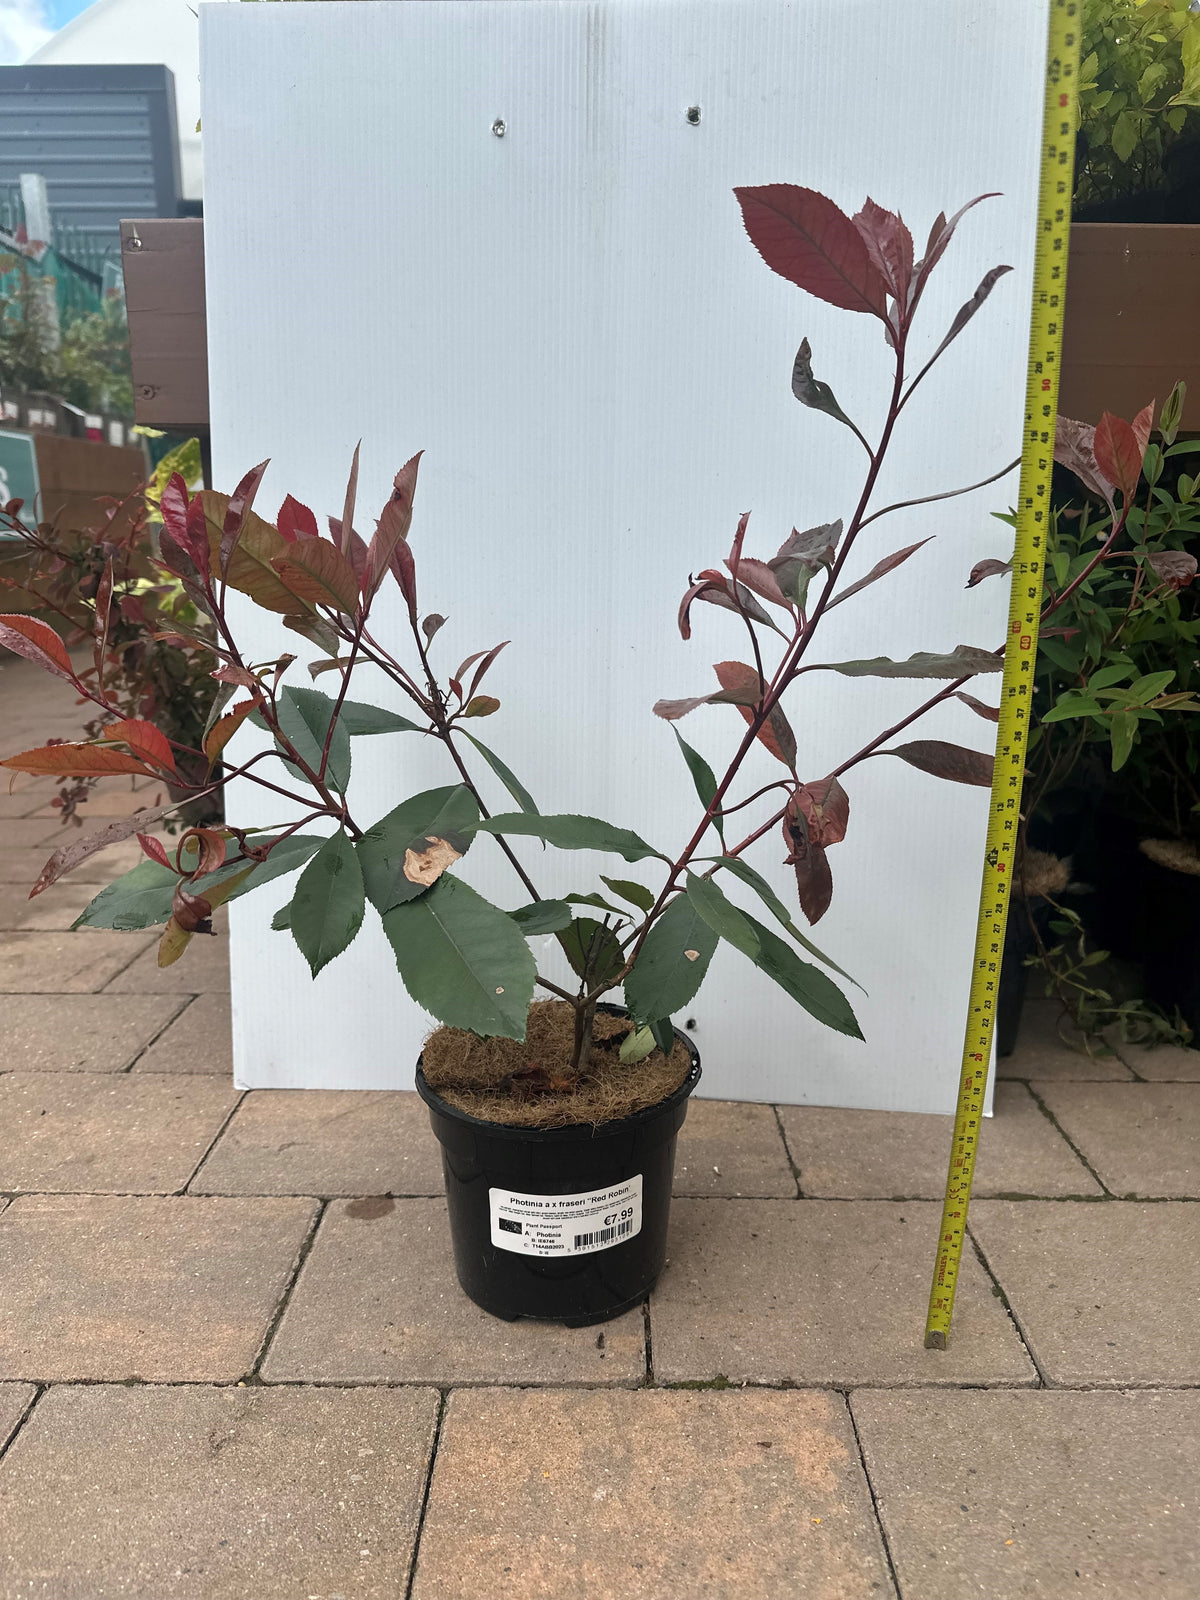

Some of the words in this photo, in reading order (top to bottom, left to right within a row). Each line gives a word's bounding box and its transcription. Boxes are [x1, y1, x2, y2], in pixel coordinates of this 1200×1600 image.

[1057, 181, 1065, 193] 57
[1055, 210, 1063, 222] 56
[1054, 238, 1062, 251] 55
[1052, 266, 1060, 279] 54
[1040, 294, 1047, 304] 21
[1050, 296, 1058, 307] 53
[1048, 323, 1056, 335] 52
[1047, 351, 1054, 362] 51
[1035, 363, 1042, 374] 20
[1042, 379, 1051, 391] 50
[1043, 405, 1051, 417] 49
[1031, 431, 1038, 442] 19
[1041, 432, 1048, 443] 48
[1039, 459, 1047, 470] 47
[1037, 485, 1044, 497] 46
[1026, 498, 1033, 508] 18
[1035, 511, 1042, 522] 45
[1033, 536, 1040, 548] 44
[1021, 564, 1028, 573] 17
[1031, 562, 1038, 574] 43
[1028, 587, 1036, 598] 42
[1026, 613, 1034, 623] 41
[1013, 622, 1020, 632] 16
[1021, 638, 1030, 649] 40
[1021, 661, 1029, 672] 39
[1009, 688, 1016, 697] 15
[1019, 685, 1027, 695] 38
[1017, 708, 1024, 719] 37
[1014, 731, 1022, 741] 36
[1003, 747, 1010, 755] 14
[1012, 754, 1019, 764] 35
[1010, 777, 1017, 786] 34
[997, 802, 1004, 811] 13
[1007, 799, 1014, 808] 33
[1005, 820, 1012, 830] 32
[1002, 843, 1009, 851] 31
[997, 863, 1005, 872] 30
[998, 884, 1005, 893] 29
[986, 910, 992, 918] 11
[996, 904, 1003, 914] 28
[994, 924, 1000, 933] 27
[991, 943, 998, 953] 26
[989, 963, 996, 972] 25
[986, 982, 993, 991] 24
[984, 1000, 991, 1009] 23
[982, 1019, 989, 1028] 22
[980, 1037, 986, 1045] 21
[510, 1198, 543, 1207] Photinia
[604, 1207, 633, 1225] €7.99
[938, 1256, 947, 1281] STANLEY
